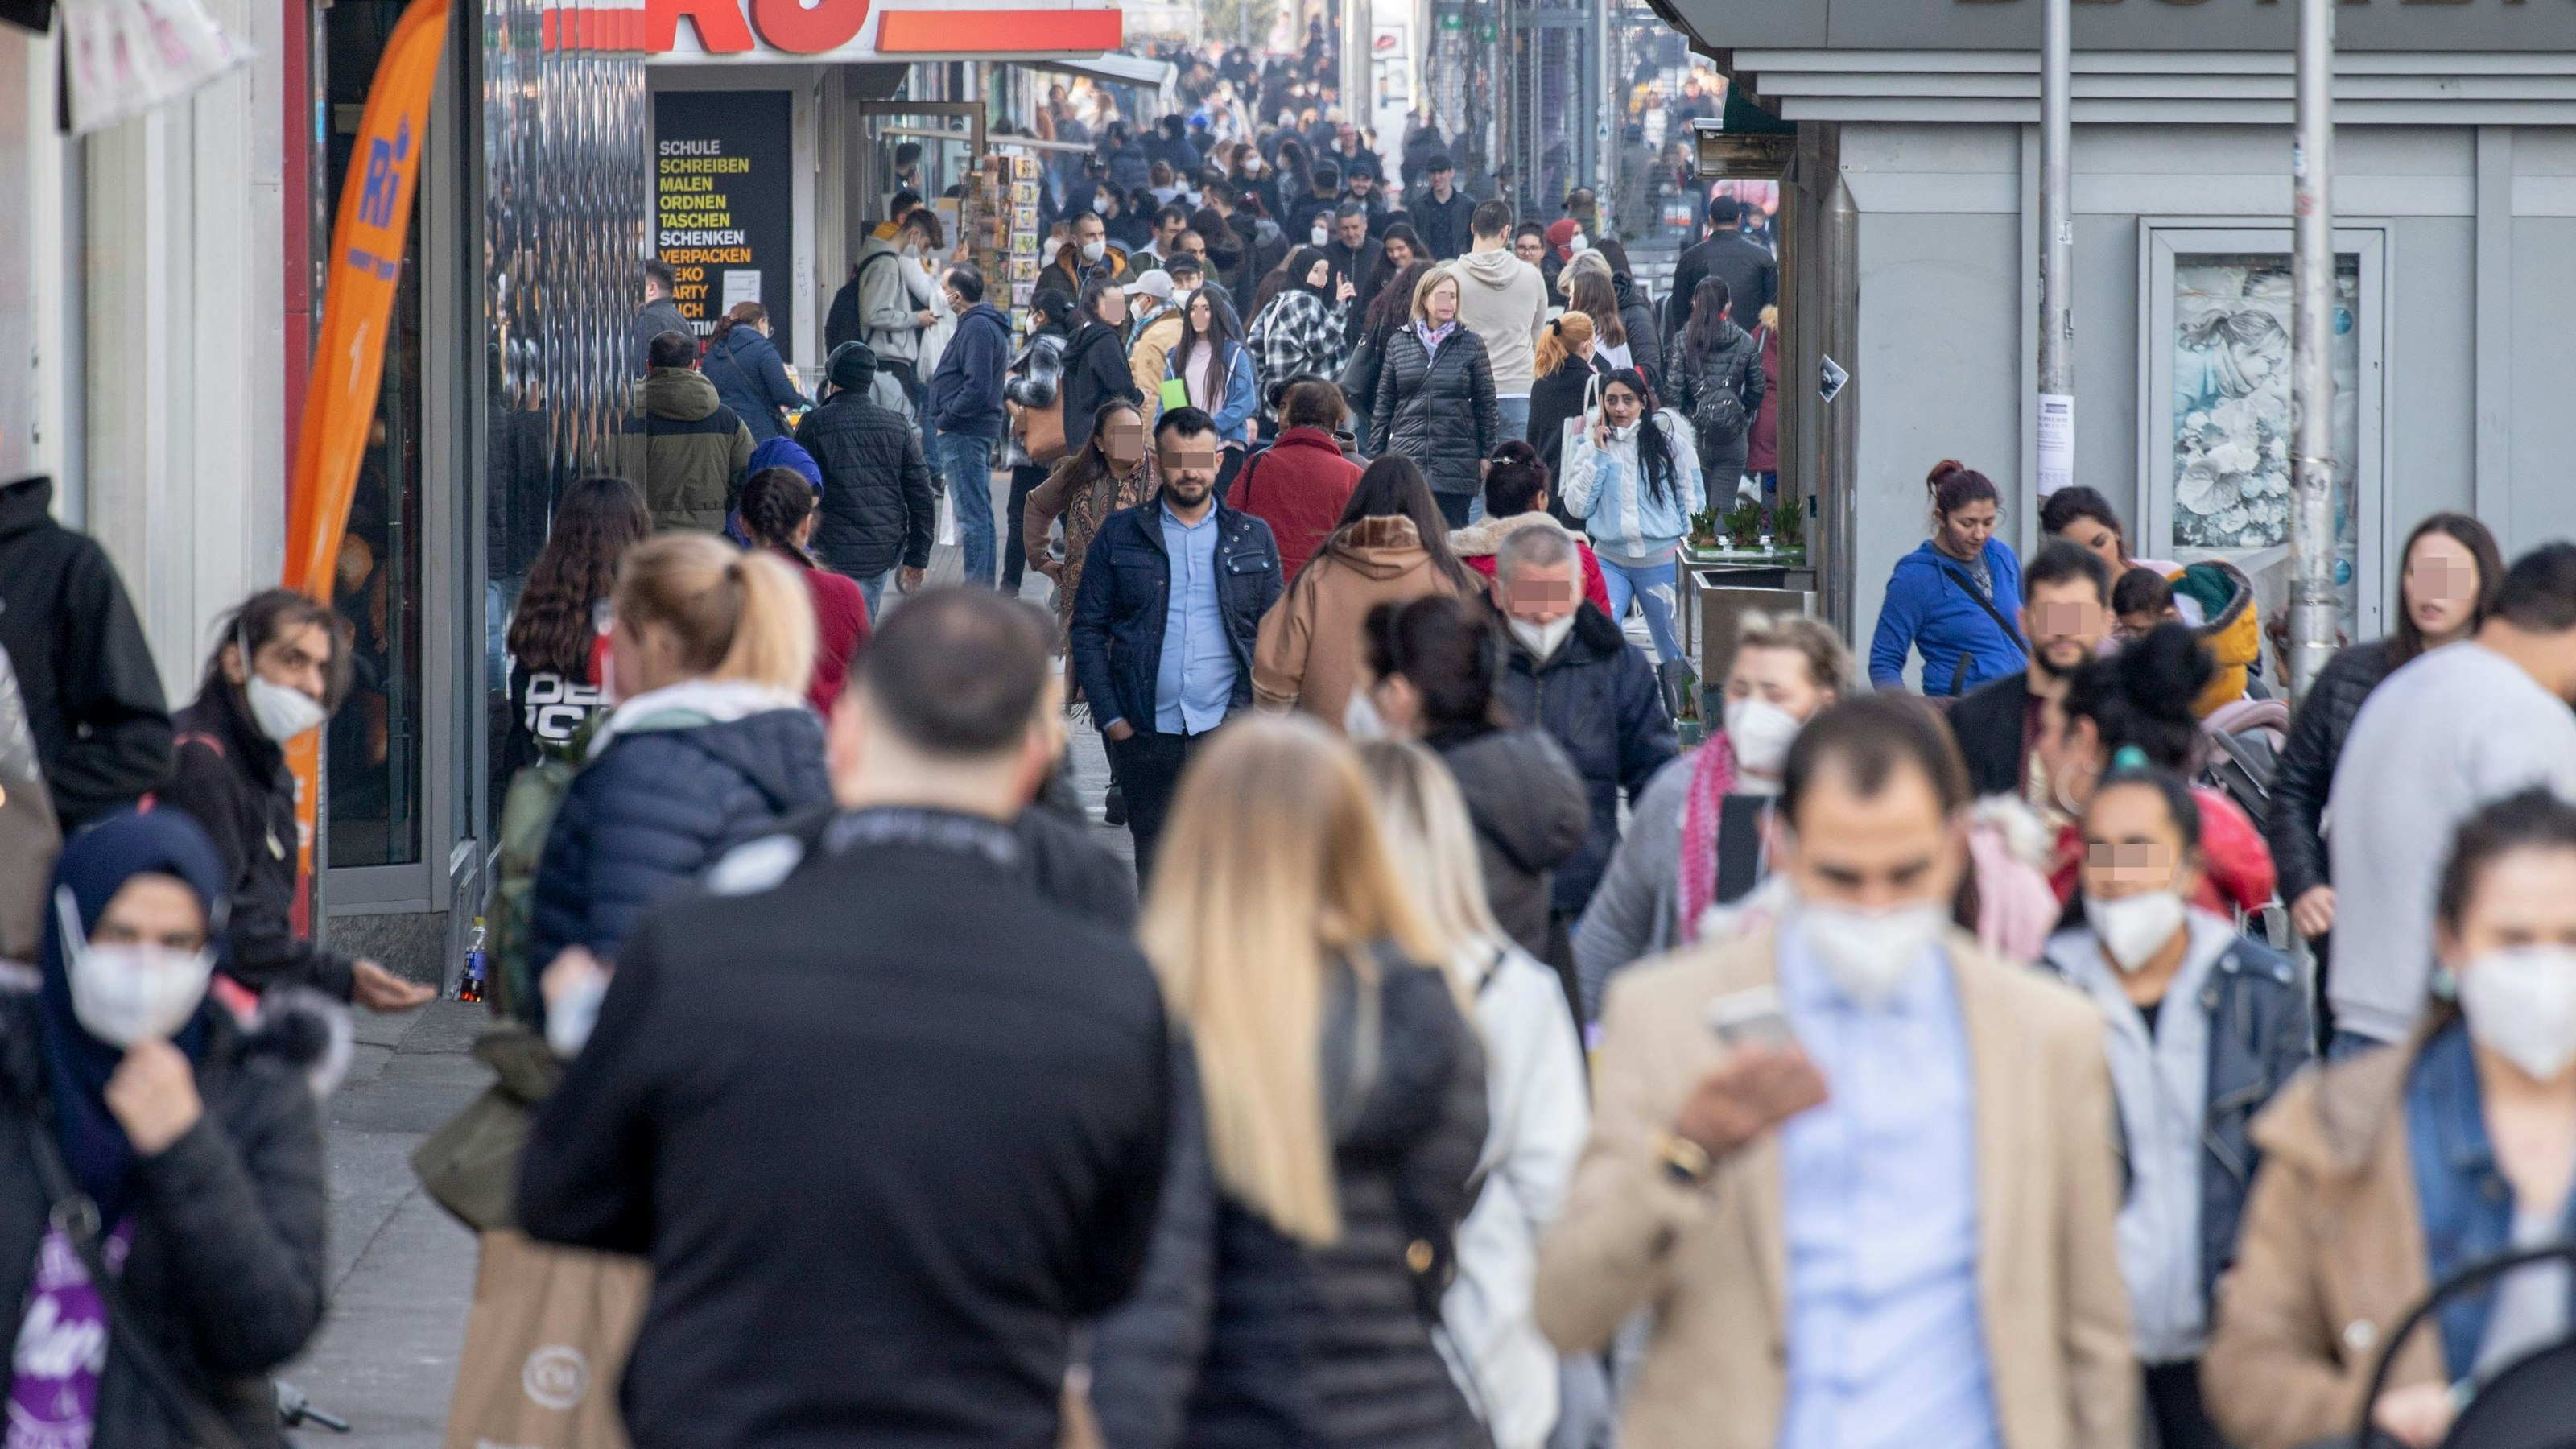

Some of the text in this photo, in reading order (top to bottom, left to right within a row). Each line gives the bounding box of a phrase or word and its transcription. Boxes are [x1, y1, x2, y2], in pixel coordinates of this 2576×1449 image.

[659, 140, 720, 155] SCHULE
[659, 159, 749, 174] SCHREIBEN
[659, 176, 713, 192] MALEN
[659, 195, 727, 209] ORDNEN
[659, 213, 730, 228] TASCHEN
[659, 230, 745, 246] SCHENKEN
[659, 248, 752, 264] VERPACKEN
[675, 267, 704, 282] EKO
[672, 285, 708, 299] ARTY
